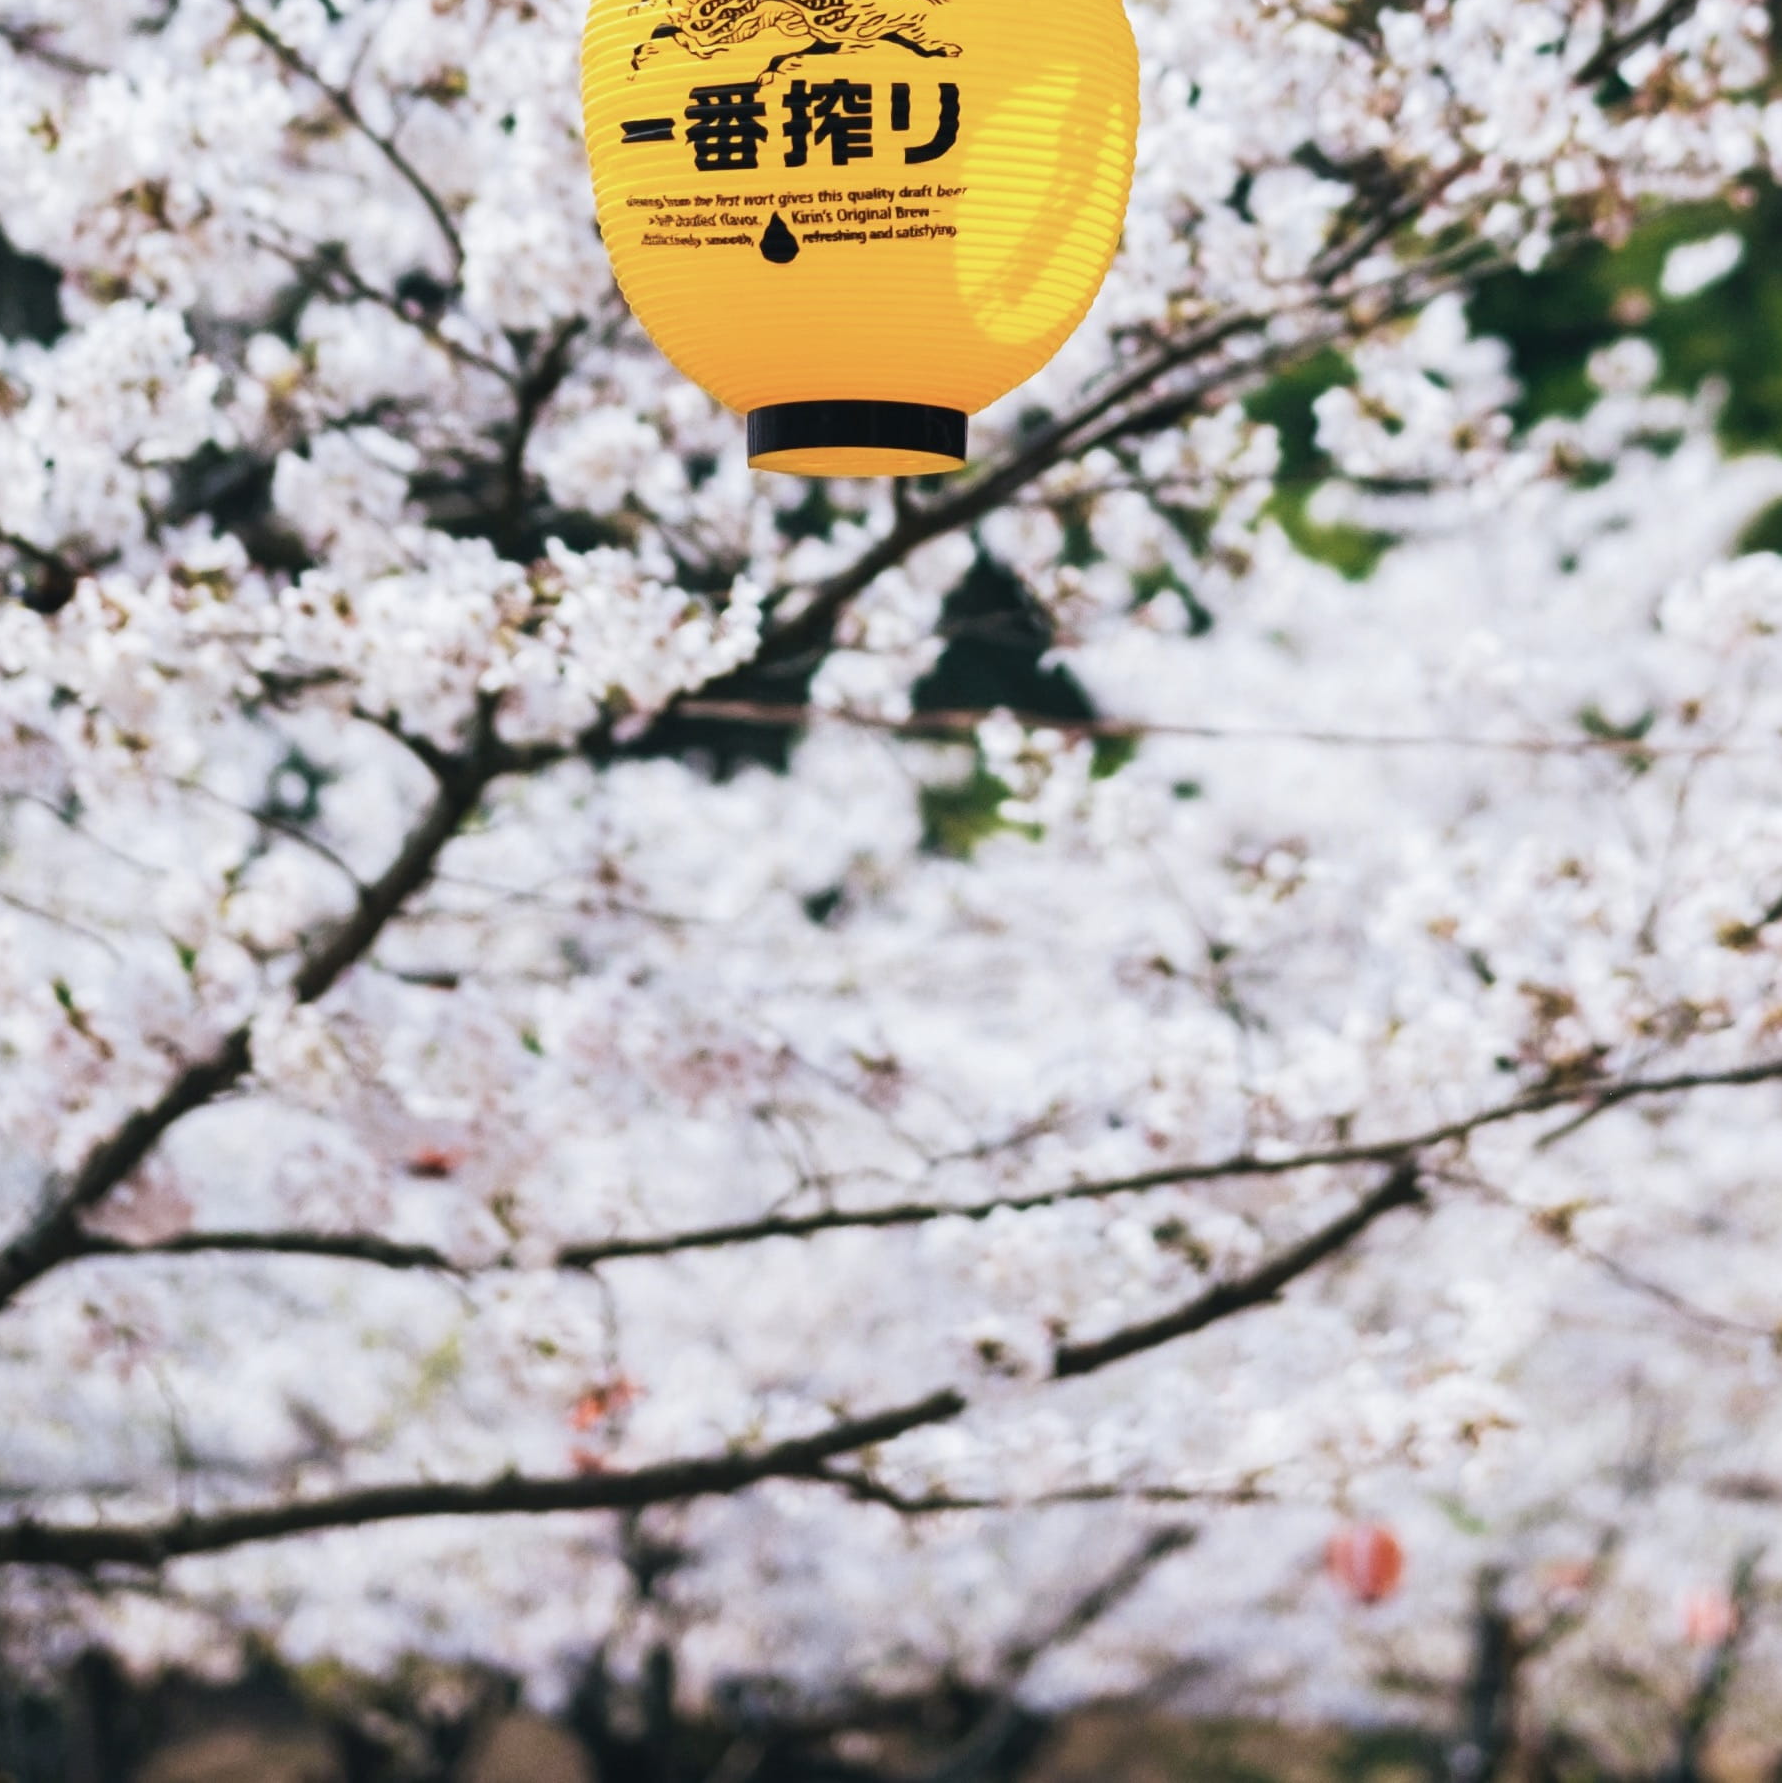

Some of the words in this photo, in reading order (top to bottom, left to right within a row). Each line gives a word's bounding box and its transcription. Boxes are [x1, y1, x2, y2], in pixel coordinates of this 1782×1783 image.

[621, 78, 960, 171] 一番搾り
[744, 193, 775, 207] wort
[778, 191, 814, 208] gives
[818, 189, 843, 203] this
[848, 187, 895, 204] quality
[898, 184, 932, 198] draft
[936, 183, 968, 198] beer
[791, 209, 833, 224] Kirin's
[837, 206, 891, 224] Original
[895, 205, 930, 219] Brew
[802, 228, 867, 244] refreshing
[869, 225, 893, 239] and
